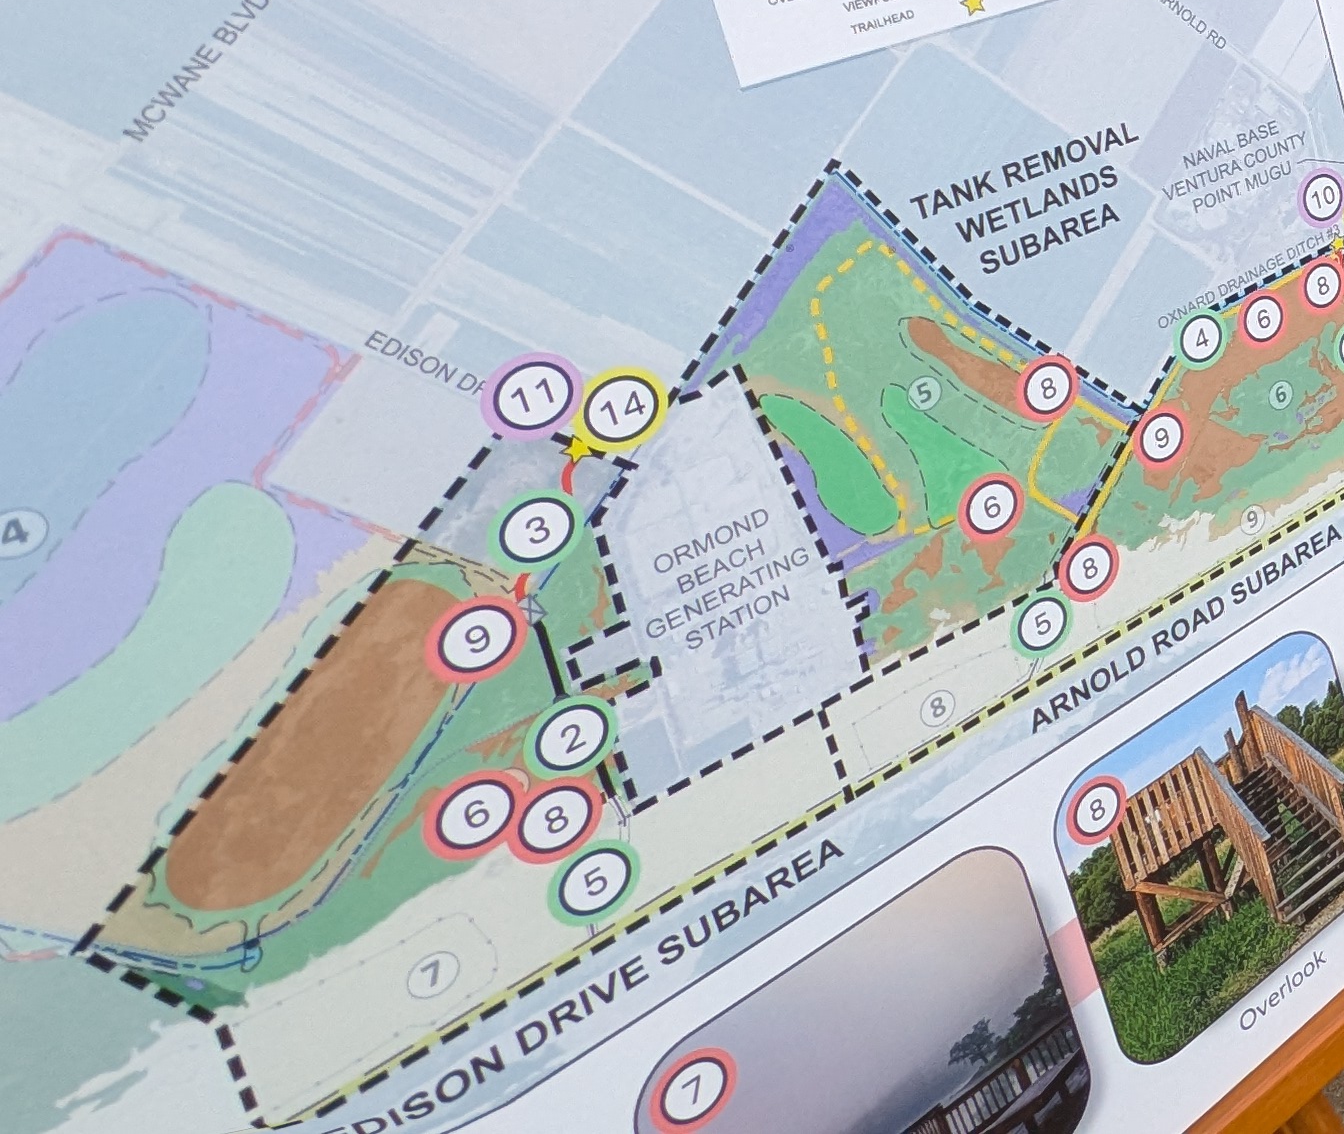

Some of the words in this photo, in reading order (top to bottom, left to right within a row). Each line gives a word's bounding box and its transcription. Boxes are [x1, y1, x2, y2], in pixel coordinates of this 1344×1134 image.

[851, 10, 915, 35] TRAILHEAD
[1201, 23, 1228, 50] RD
[123, 43, 221, 143] MCWANE
[910, 170, 998, 219] TANK
[1002, 123, 1139, 187] REMOVAL
[1162, 160, 1242, 201] VENTURA
[1243, 131, 1307, 168] COUNTY
[1183, 139, 1235, 169] NAVAL
[1236, 120, 1279, 149] BASE
[955, 165, 1118, 243] WETLANDS
[1192, 181, 1241, 213] POINT
[1246, 161, 1292, 191] MUGU
[1311, 186, 1335, 209] 10
[980, 203, 1120, 274] SUBAREA
[1158, 290, 1215, 329] OXNARD
[1218, 255, 1286, 298] DRAINAGE
[1286, 232, 1324, 263] DITCH
[365, 329, 455, 384] EDISON
[510, 377, 556, 414] 11
[600, 390, 646, 425] 14
[654, 508, 769, 573] ORMOND
[677, 538, 765, 594] BEACH
[646, 547, 809, 639] GENERATING
[685, 585, 790, 649] STATION
[1032, 645, 1145, 734] ARNOLD
[1152, 596, 1225, 656] ROAD
[1230, 524, 1342, 604] SUBAREA
[322, 1044, 506, 1134] DISON
[515, 955, 650, 1057] DRIVE
[658, 837, 845, 967] SUBAREA
[1237, 948, 1329, 1034] Overlook
